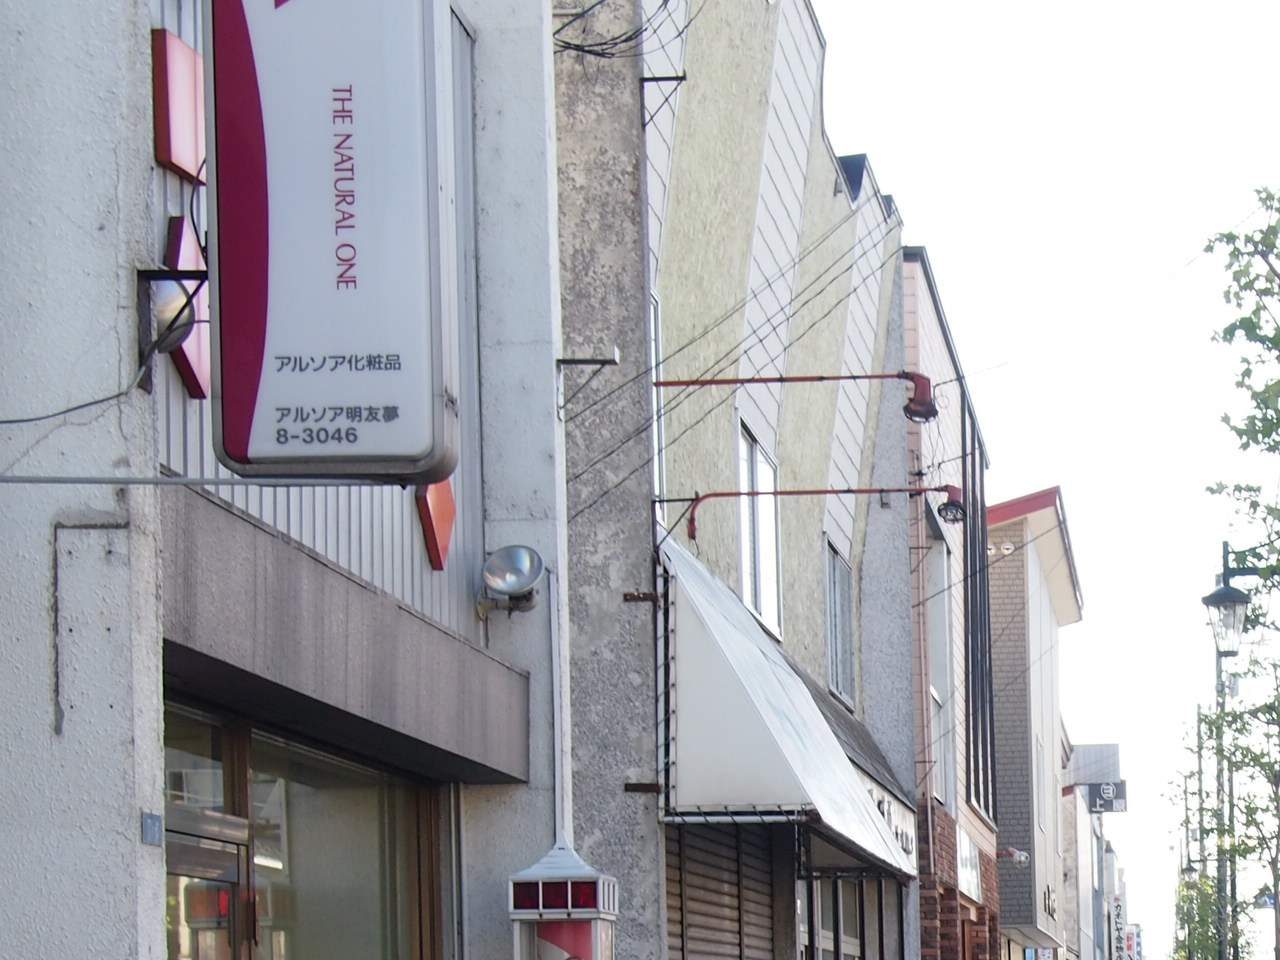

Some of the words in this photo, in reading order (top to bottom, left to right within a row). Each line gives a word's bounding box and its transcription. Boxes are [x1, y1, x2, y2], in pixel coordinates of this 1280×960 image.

[332, 84, 353, 125] THE
[333, 133, 356, 236] NATURAL
[335, 243, 357, 290] ONE
[274, 354, 402, 372] アルソア化粧品
[275, 406, 400, 423] アルソア明友夢
[276, 427, 359, 444] 8-3046
